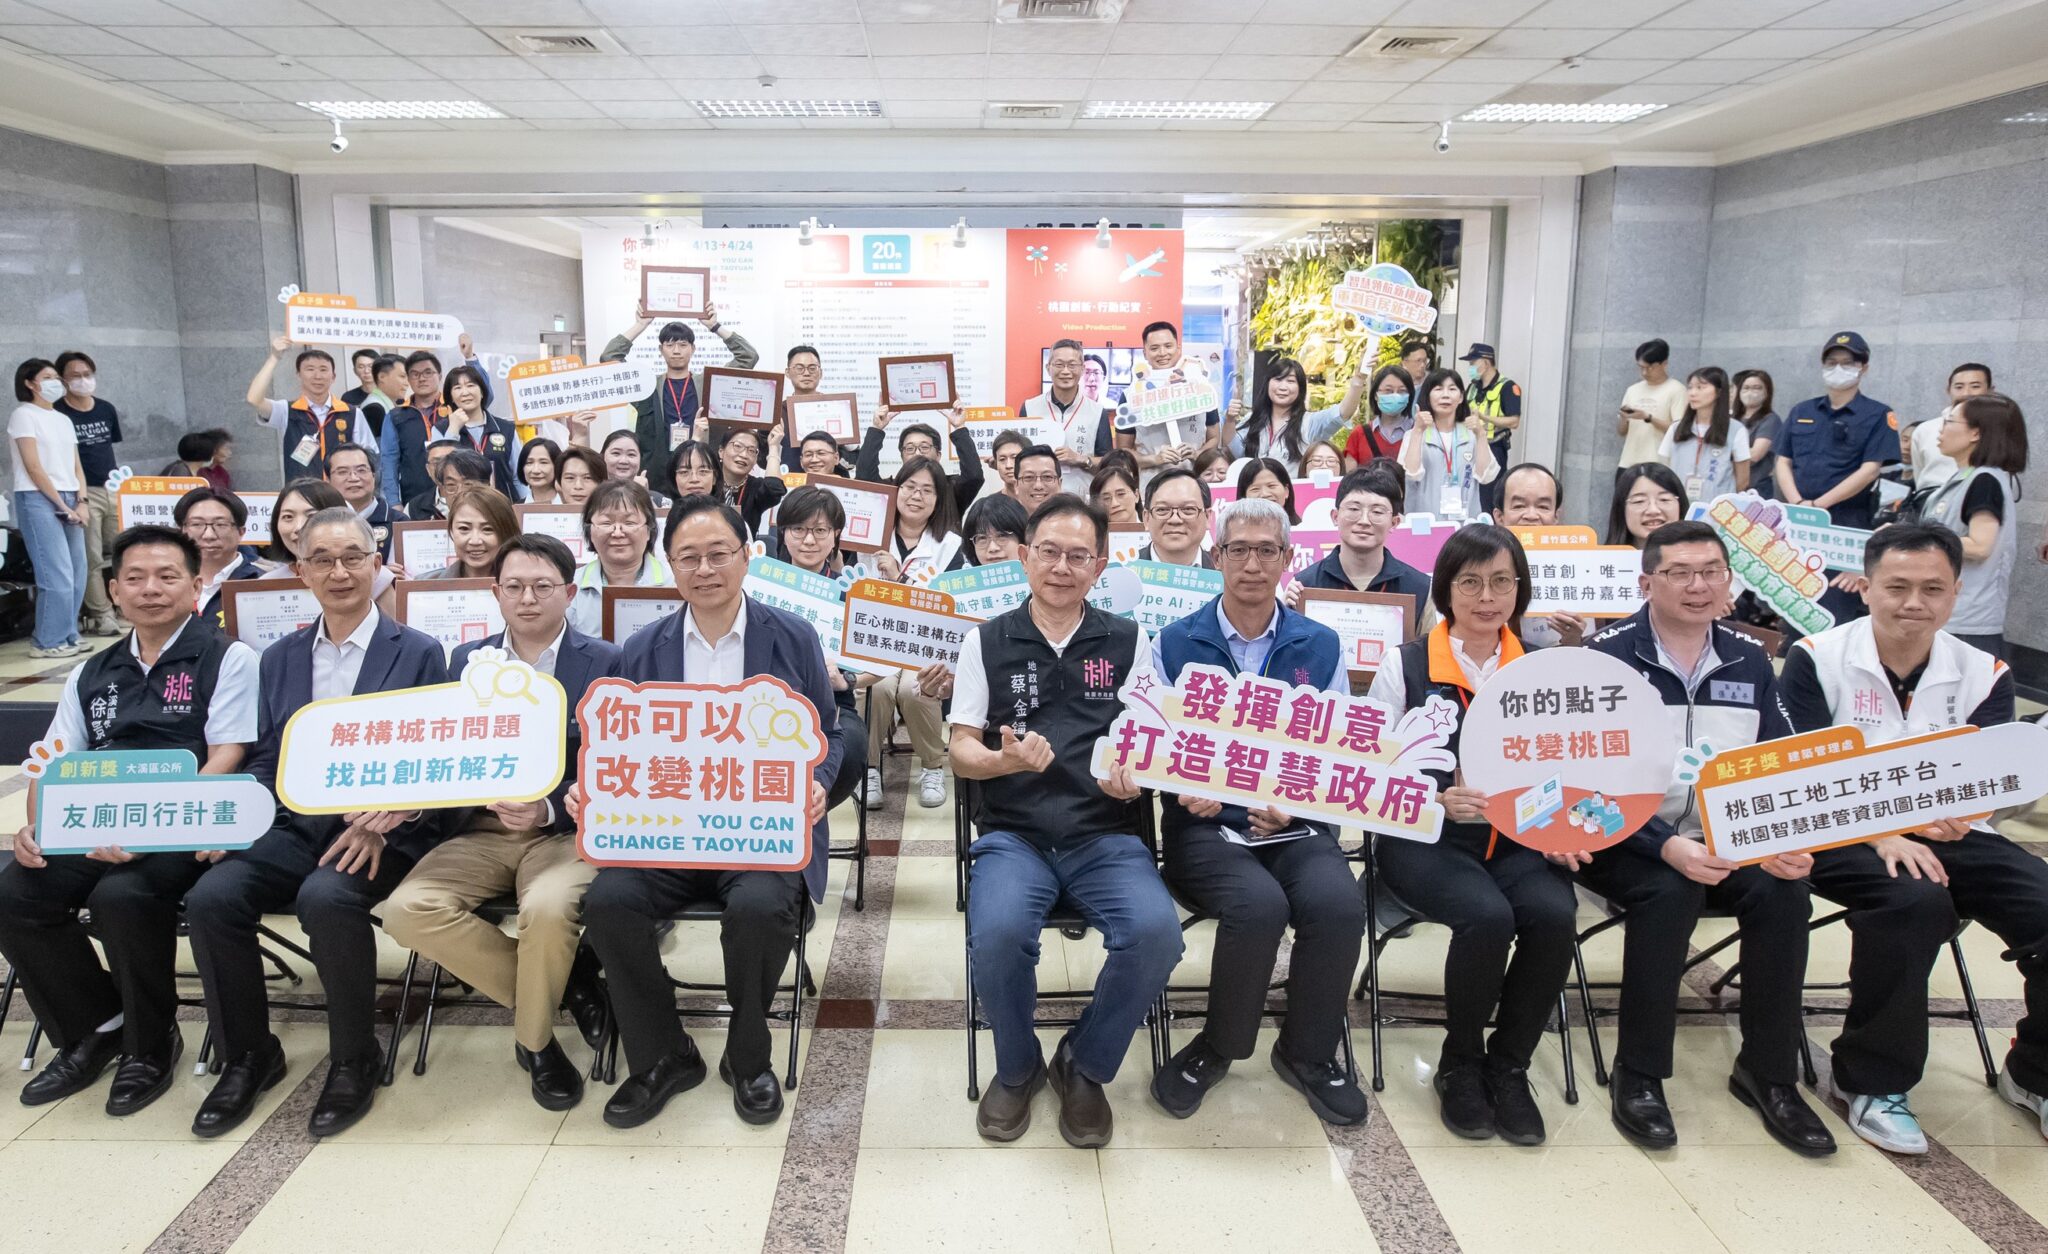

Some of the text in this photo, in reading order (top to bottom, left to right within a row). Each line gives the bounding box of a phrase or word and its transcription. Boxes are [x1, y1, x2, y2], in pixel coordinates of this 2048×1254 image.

[1062, 323, 1126, 331] Video Production
[518, 363, 548, 376] 點子獎
[130, 480, 165, 492] 點子獎
[759, 562, 797, 585] 創新獎
[863, 583, 904, 604] 點子獎
[1027, 660, 1040, 709] 地政局長
[1499, 684, 1627, 718] 你的點子
[330, 713, 521, 747] 解構城市問題
[595, 696, 746, 744] 你可以
[1183, 671, 1387, 755] 發揮創意
[1502, 729, 1631, 762] 改變桃園
[1716, 739, 1854, 780] 點子獎 建築管理處
[59, 760, 182, 778] 創新獎 大溪區公所
[325, 753, 519, 788] 找出創新解方
[596, 754, 795, 804] 改變桃園
[1115, 718, 1429, 826] 打造智慧政府
[1725, 760, 1938, 822] 桃園工地工好平台
[62, 800, 238, 829] 友廁同行計畫
[697, 814, 794, 832] YOU CAN
[1730, 774, 2022, 848] 桃園智慧建管資訊圖台精進計畫
[594, 834, 793, 854] CHANGE TAOYUAN
